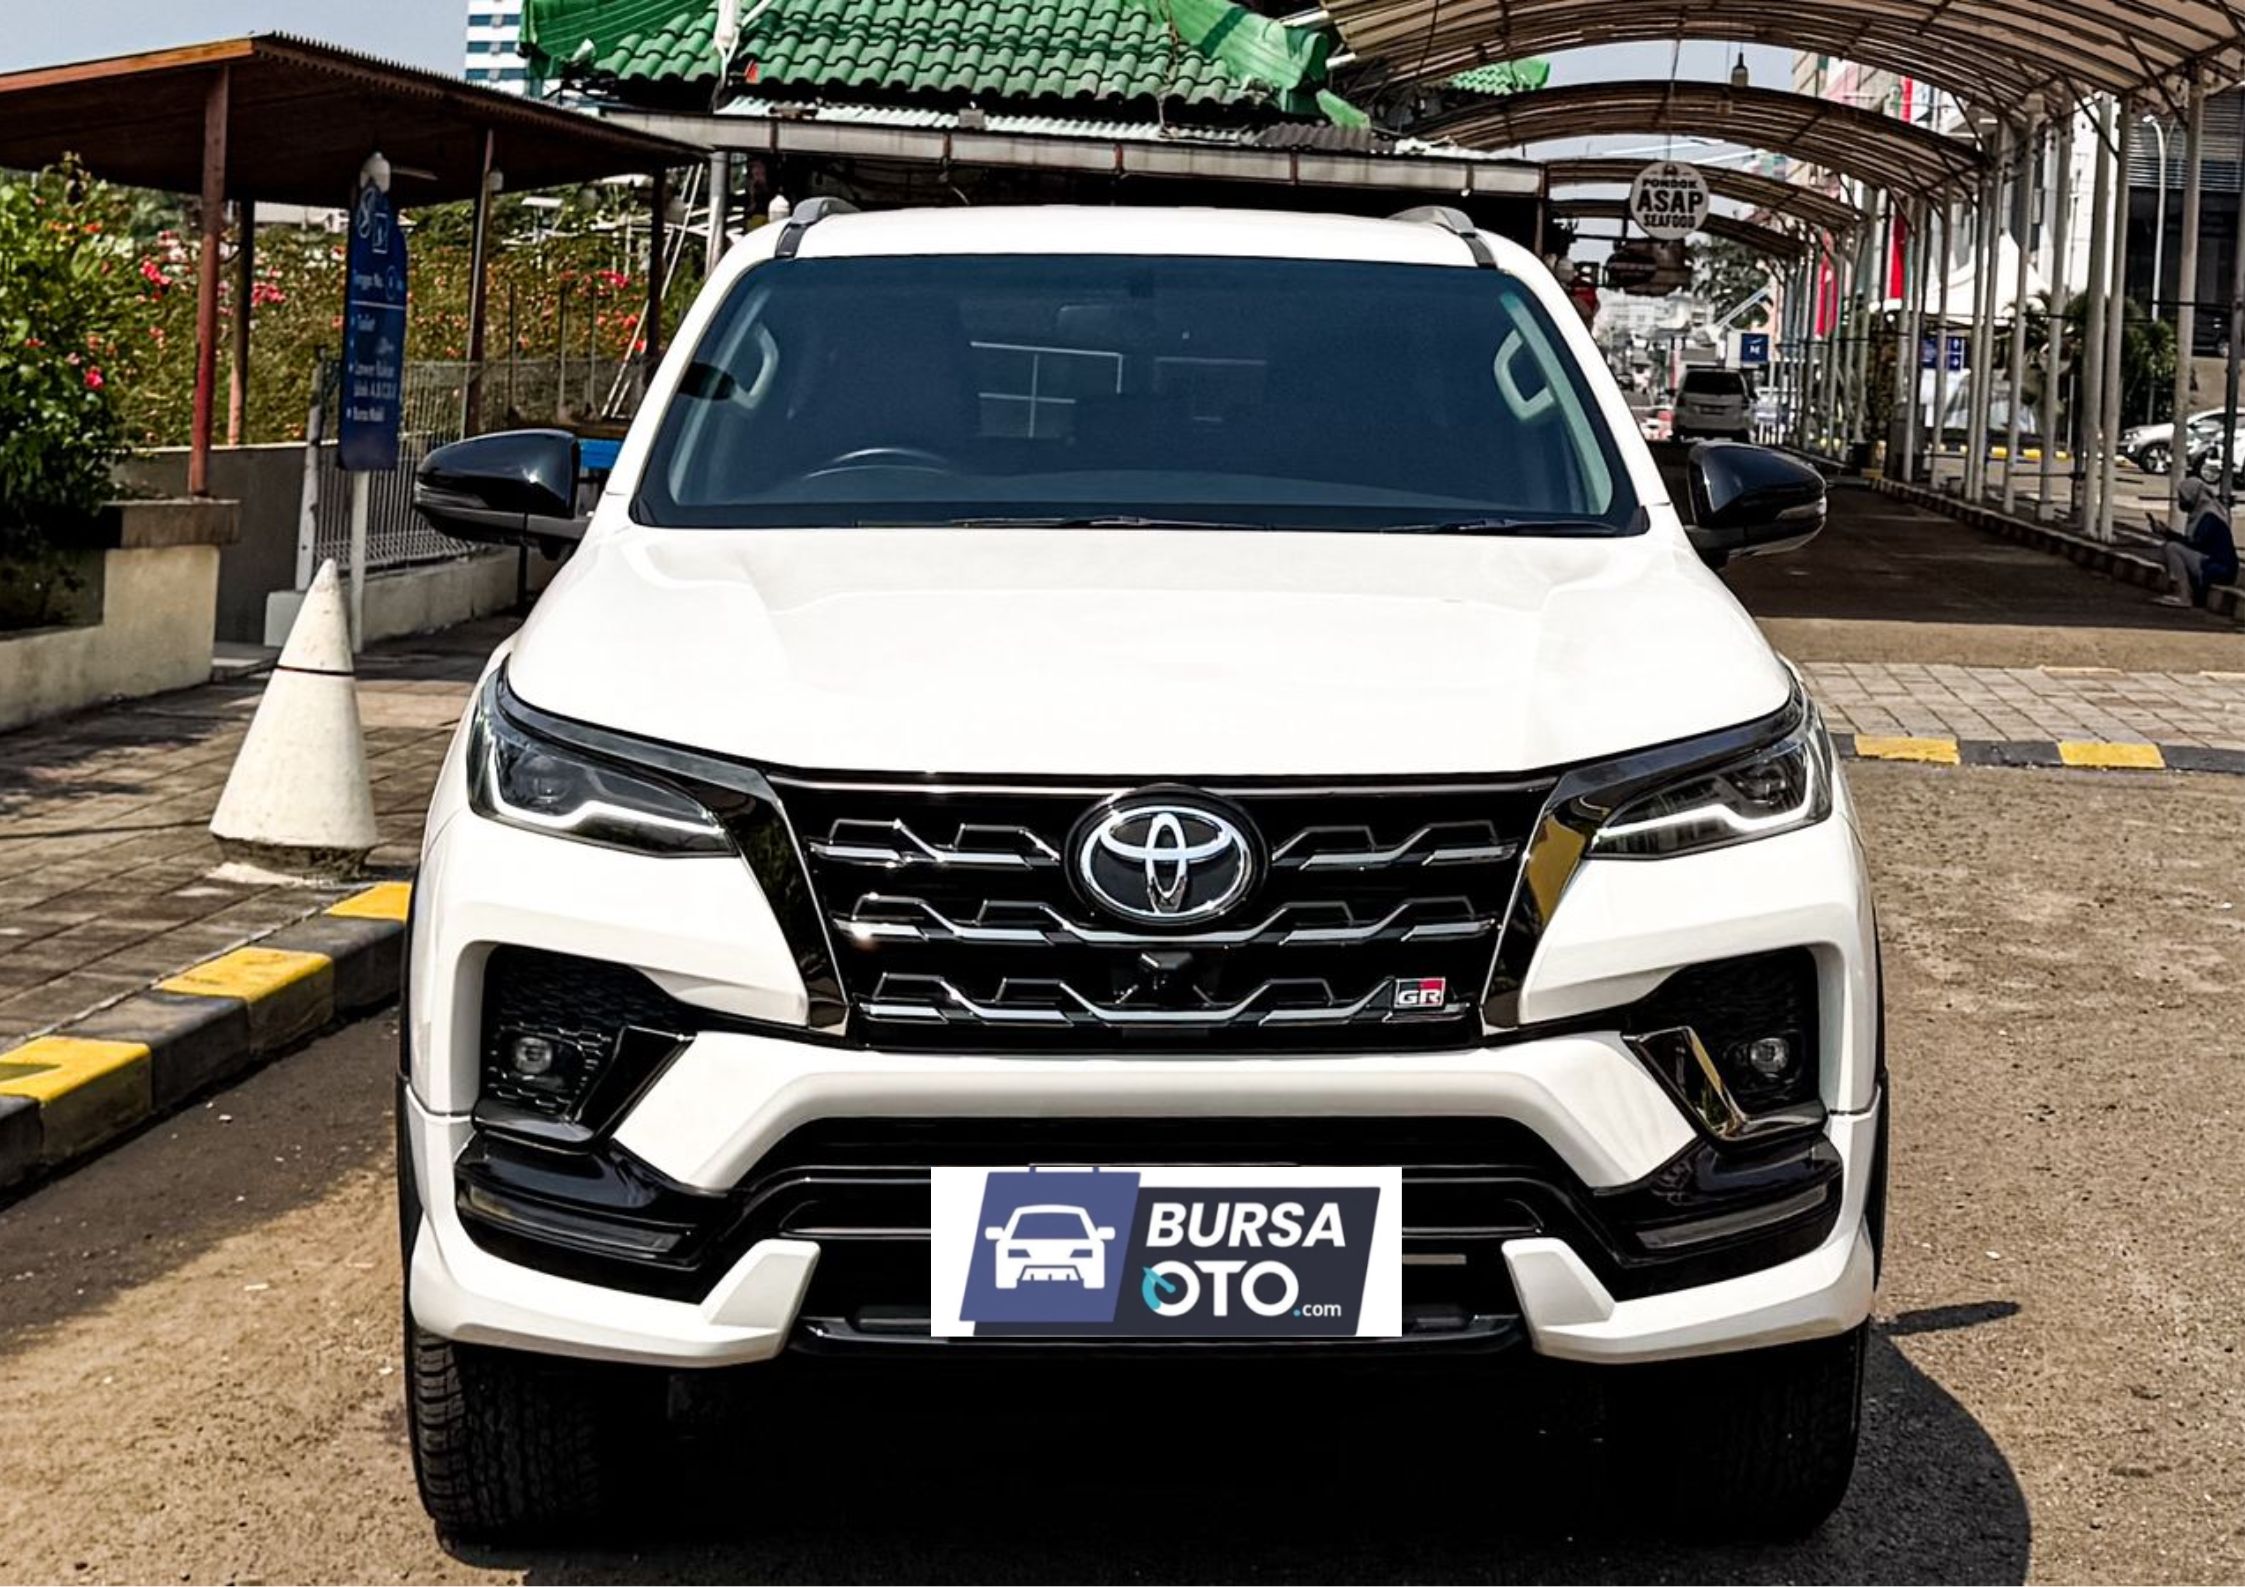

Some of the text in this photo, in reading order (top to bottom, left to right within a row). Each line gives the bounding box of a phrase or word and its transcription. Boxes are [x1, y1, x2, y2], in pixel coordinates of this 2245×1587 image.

[1642, 178, 1698, 189] PONDOK
[1637, 188, 1703, 213] ASAP
[1644, 213, 1696, 228] SEAFOOD
[1398, 988, 1441, 1004] GR
